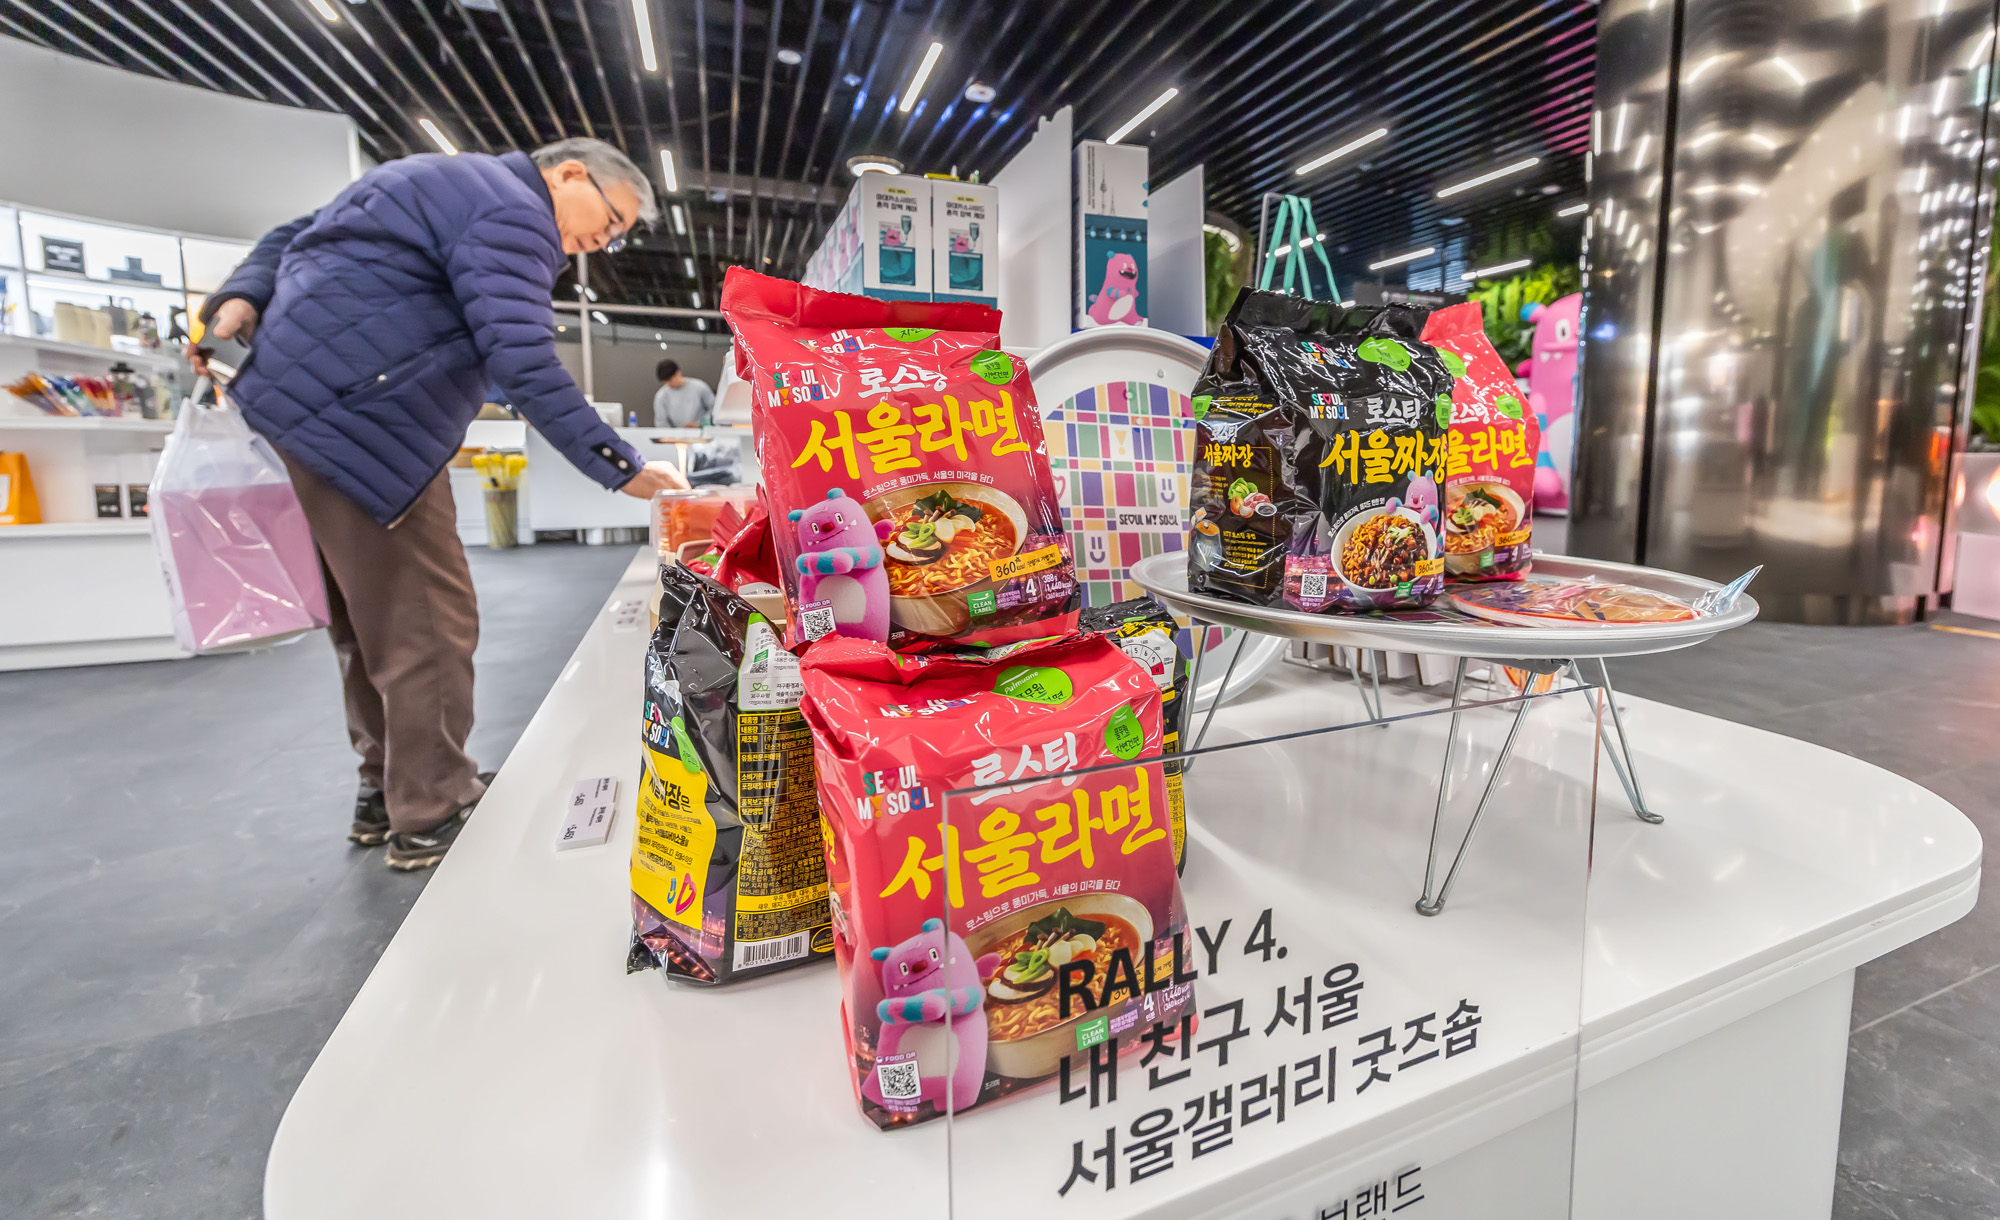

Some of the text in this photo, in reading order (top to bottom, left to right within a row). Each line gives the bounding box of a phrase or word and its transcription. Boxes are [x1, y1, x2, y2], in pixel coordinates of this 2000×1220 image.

[792, 384, 830, 404] SOUL
[1311, 393, 1344, 406] SEOUL
[1325, 405, 1350, 420] SOUL
[1365, 397, 1422, 428] 로스팅
[790, 389, 1031, 481] 서울라면
[1210, 425, 1238, 443] 로스팅
[1203, 442, 1254, 468] 서울짜장
[1318, 428, 1449, 485] 서울짜장
[1447, 422, 1534, 476] 울라면
[933, 470, 955, 480] 서울의
[956, 470, 978, 481] 미각을
[979, 473, 994, 485] 담다
[1119, 514, 1144, 525] SEOUL
[1159, 514, 1179, 526] SOUL
[995, 561, 1016, 578] 360
[1418, 563, 1430, 575] 360
[1025, 578, 1037, 596] 4
[806, 601, 821, 609] FOOD
[973, 600, 992, 609] CLEAN
[974, 606, 993, 615] LABEL
[1004, 671, 1039, 694] Pulmuone
[649, 722, 670, 749] SOUL
[1113, 724, 1130, 741] 풀무원
[969, 731, 1078, 806] 로스팅
[863, 764, 921, 795] SEOUL
[886, 786, 934, 815] SOUL
[878, 765, 1167, 909] 서울라면
[1012, 888, 1050, 909] 풍미가득,
[1052, 882, 1078, 897] 서울의
[1079, 879, 1104, 892] 미각을
[1105, 879, 1121, 891] 담다
[1059, 907, 1288, 1019] RALLY 4.
[1143, 993, 1155, 1012] 4
[1059, 962, 1365, 1109] 내 친구 서울
[1081, 1027, 1104, 1041] CLEAN
[1082, 1035, 1104, 1047] LABEL
[1057, 998, 1483, 1198] 서울갤러리 굿즈숍
